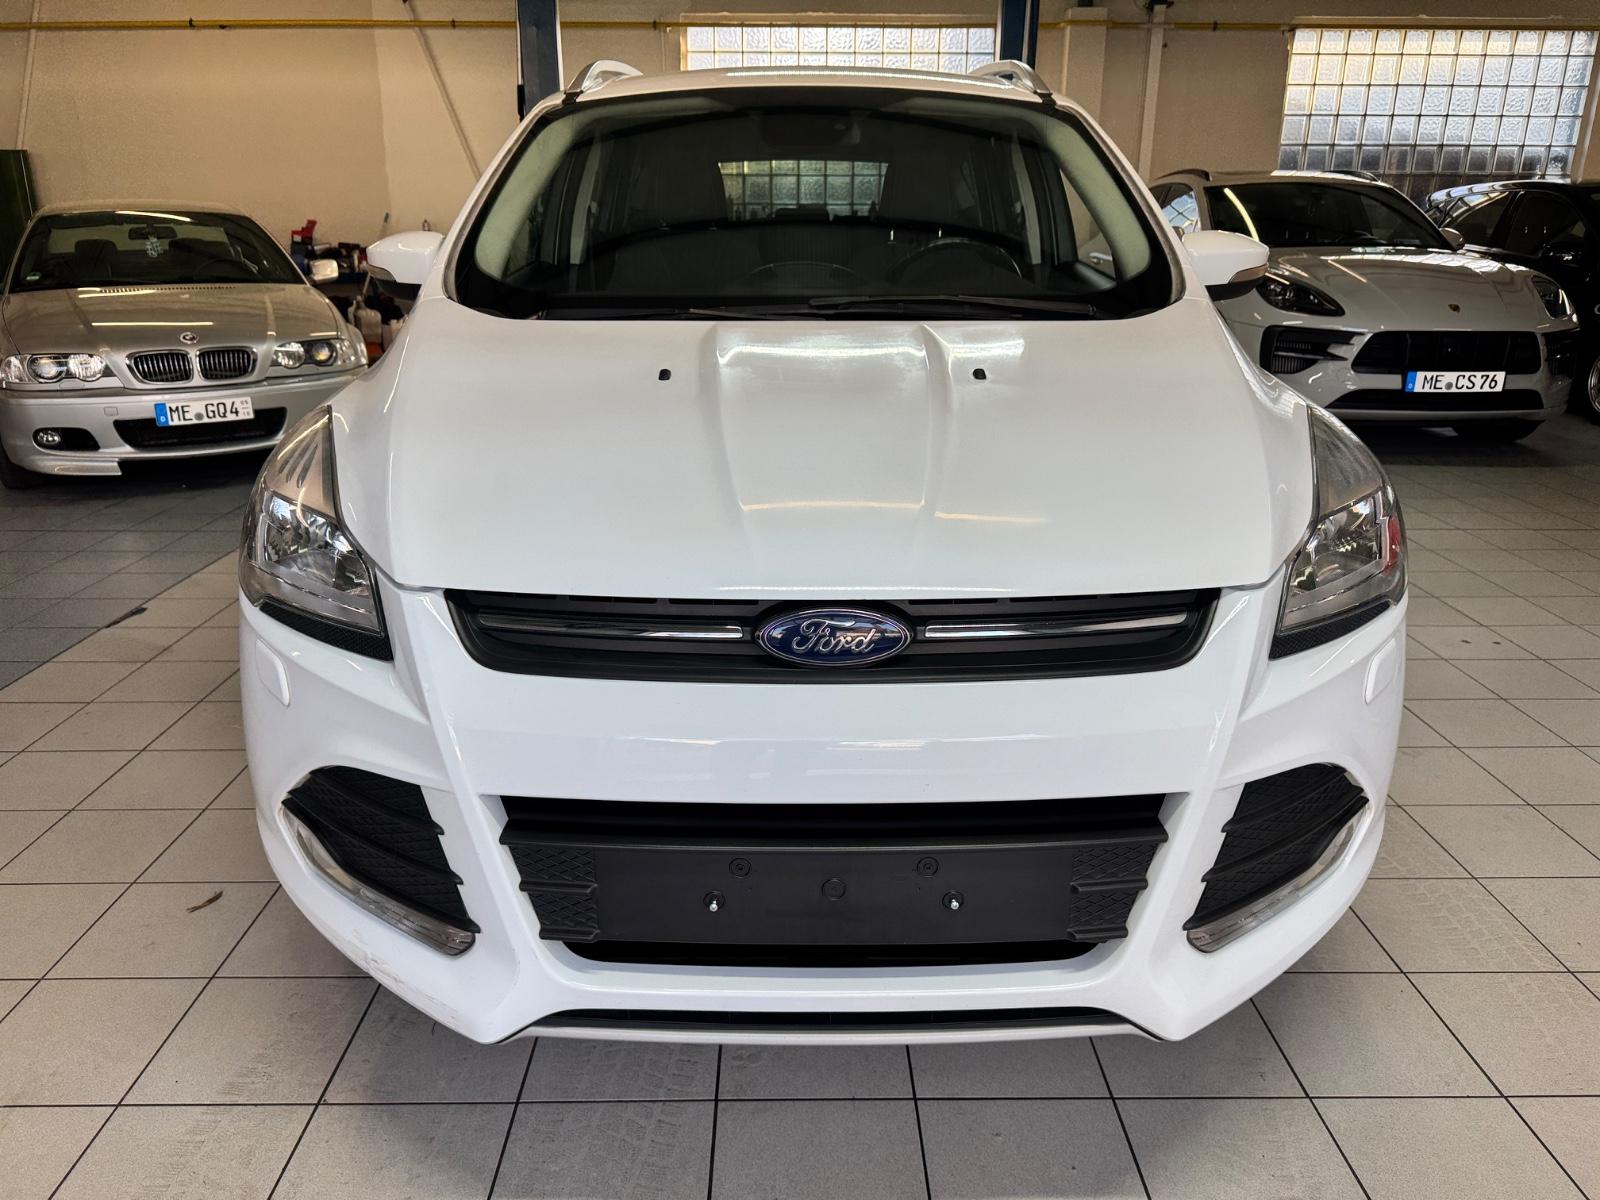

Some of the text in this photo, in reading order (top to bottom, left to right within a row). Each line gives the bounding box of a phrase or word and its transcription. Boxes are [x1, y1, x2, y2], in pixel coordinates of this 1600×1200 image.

[1422, 374, 1445, 390] ME
[168, 404, 193, 423] ME
[791, 618, 879, 654] Ford
